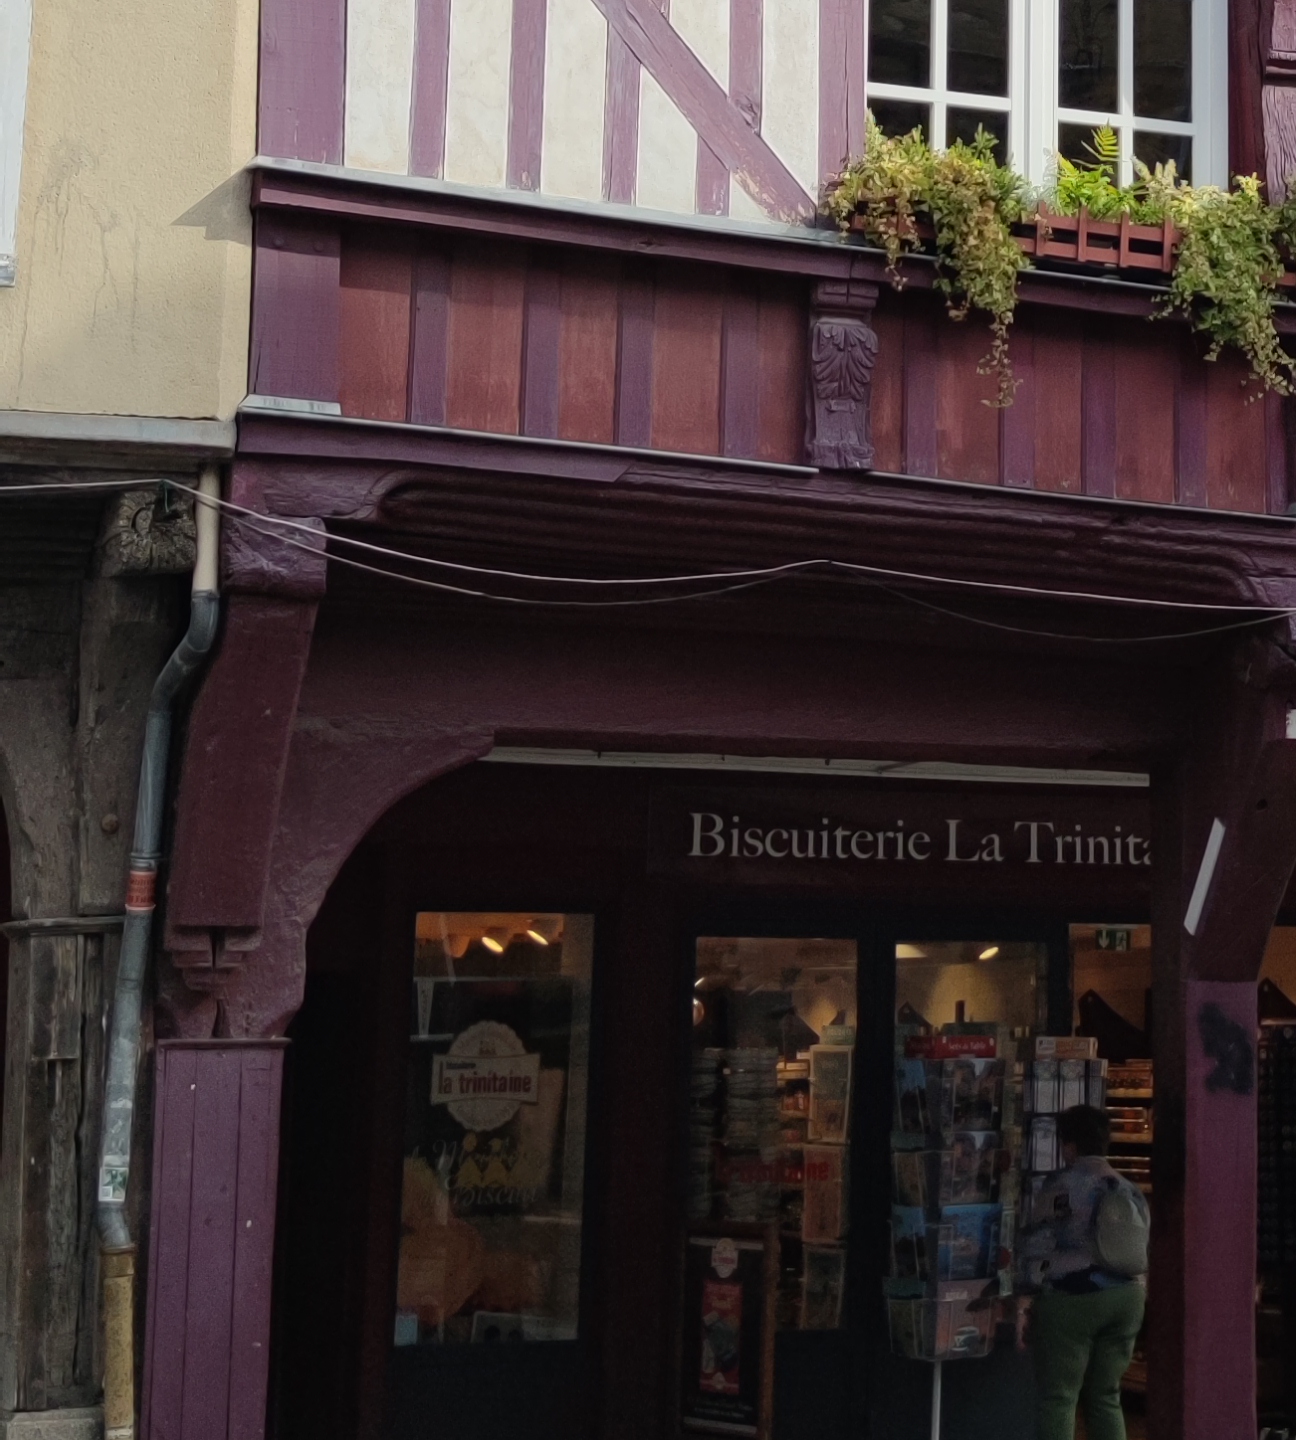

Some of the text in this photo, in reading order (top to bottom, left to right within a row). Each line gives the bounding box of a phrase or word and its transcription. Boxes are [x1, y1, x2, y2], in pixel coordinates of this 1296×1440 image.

[687, 811, 932, 861] Biscuiterie
[944, 819, 1005, 863] La
[437, 1060, 532, 1094] la trinitaine
